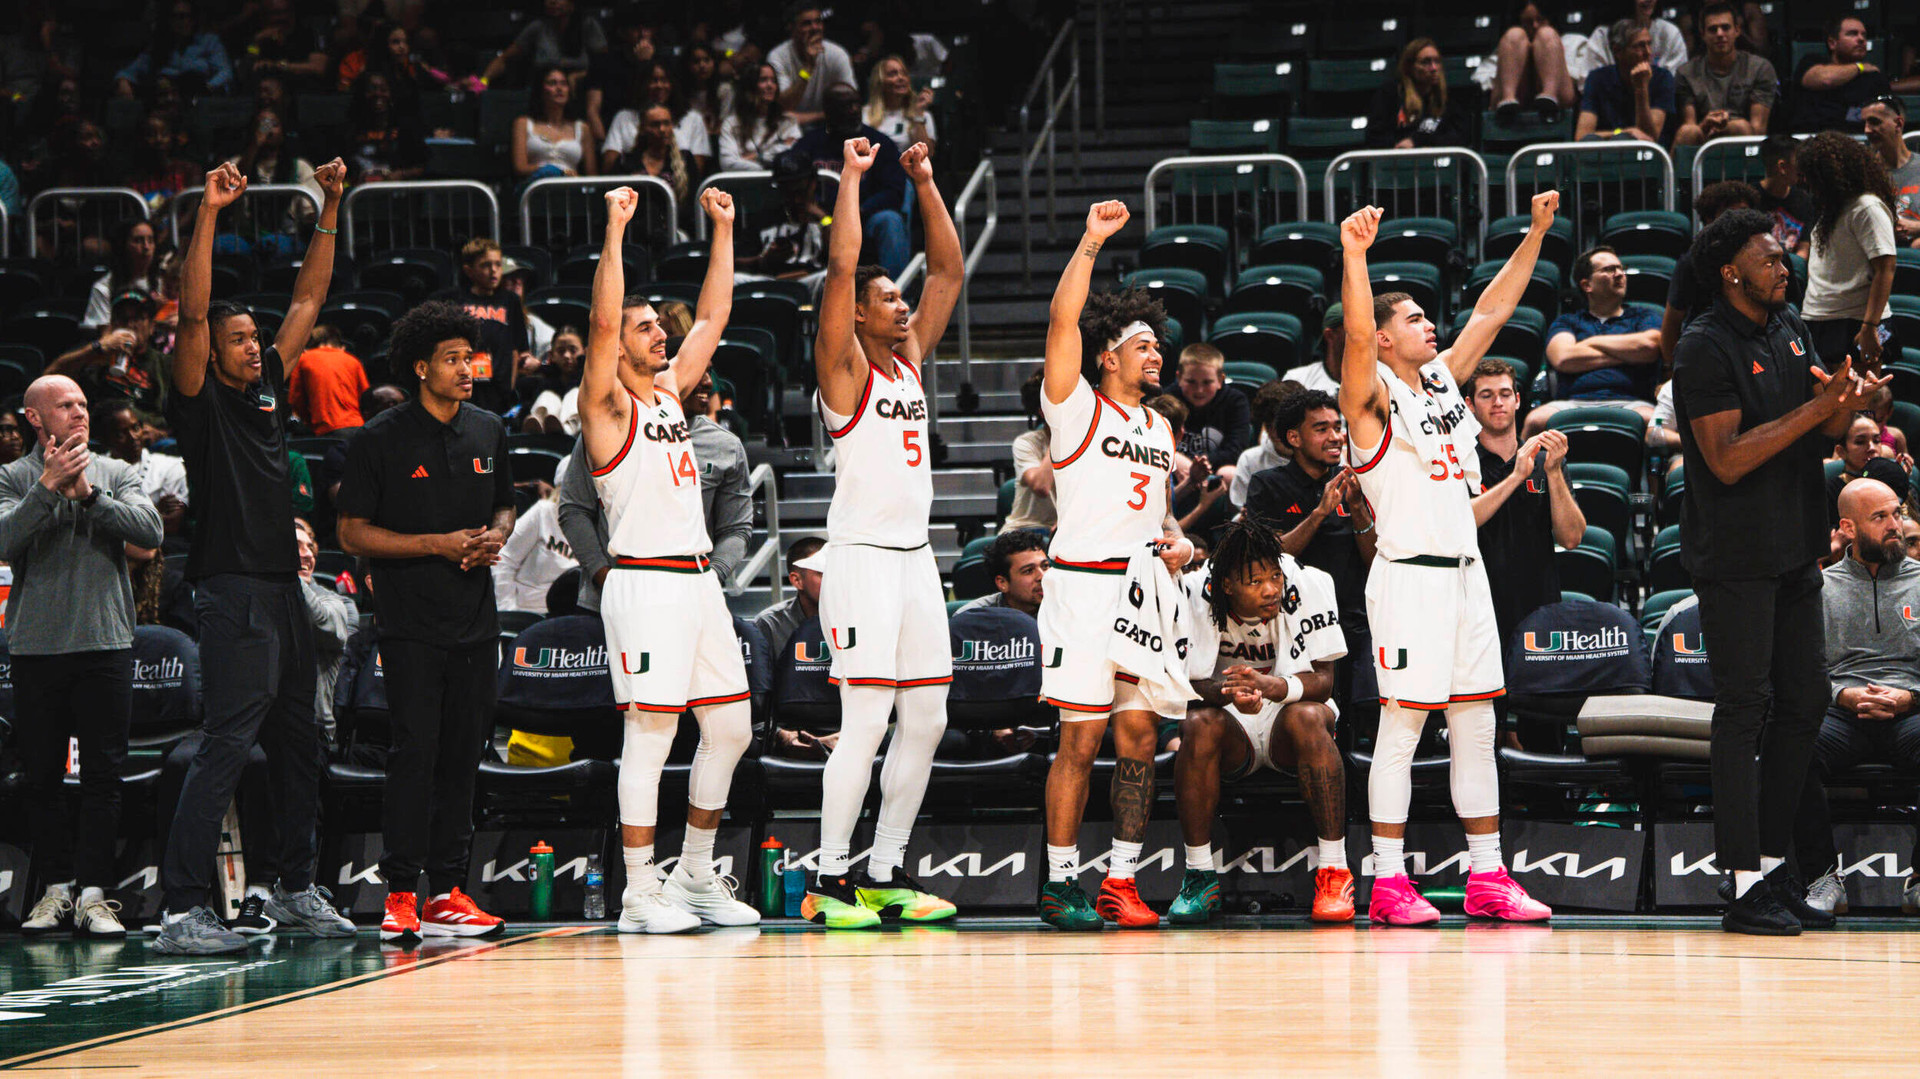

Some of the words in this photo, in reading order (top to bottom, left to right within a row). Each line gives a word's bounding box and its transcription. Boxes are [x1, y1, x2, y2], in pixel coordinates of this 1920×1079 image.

[903, 431, 922, 467] 5
[1101, 436, 1170, 471] CANES
[473, 457, 493, 474] U
[667, 451, 696, 486] 14
[1127, 471, 1151, 511] 3
[831, 627, 856, 650] U
[1114, 617, 1163, 652] GATO
[1524, 626, 1628, 652] UHealth
[514, 645, 608, 670] UHealth
[621, 652, 650, 675] U
[1014, 661, 1034, 669] SYSTEM
[1379, 647, 1407, 670] U
[1566, 653, 1585, 661] MIAMI
[1586, 652, 1606, 660] HEALTH
[1607, 650, 1629, 658] SYSTEM
[918, 852, 1026, 877] KIA
[1512, 848, 1626, 881] KIA
